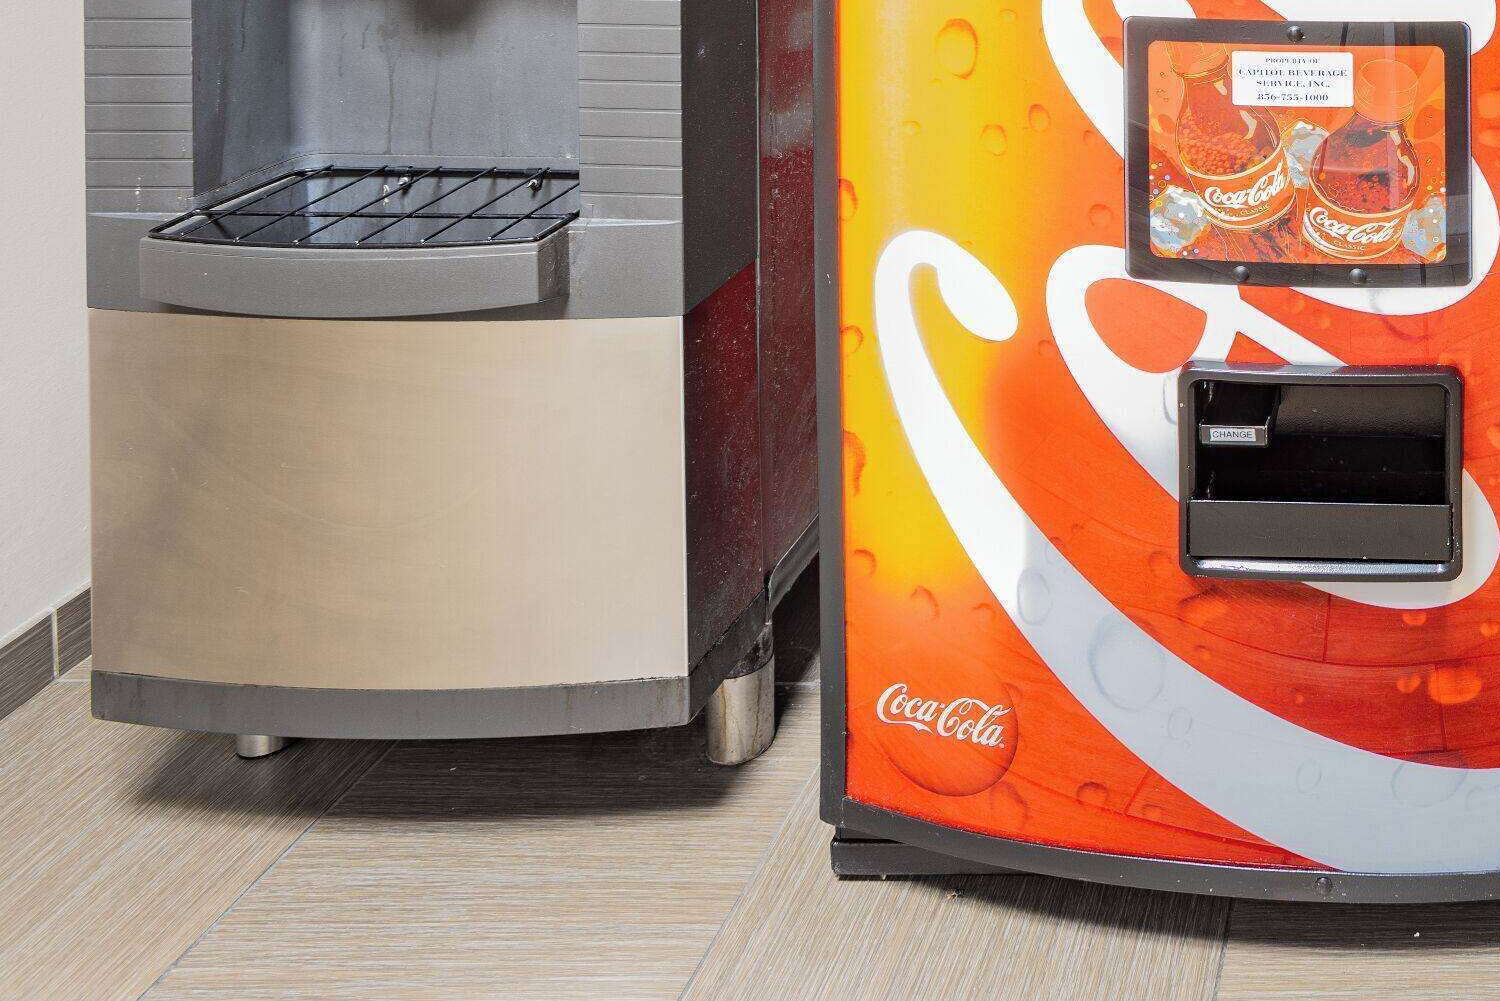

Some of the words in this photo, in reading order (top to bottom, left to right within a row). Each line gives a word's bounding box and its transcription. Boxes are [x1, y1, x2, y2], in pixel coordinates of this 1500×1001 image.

[1288, 69, 1348, 77] BEVERAGE
[1308, 80, 1330, 88] INC.
[1204, 160, 1286, 210] Coca-Cola
[1240, 203, 1271, 217] CLASSIC
[1309, 206, 1402, 244] Coca-Cola
[1333, 240, 1366, 251] CLASSIC
[1212, 430, 1253, 439] CHANGE
[876, 683, 1014, 749] Coca-Cola
